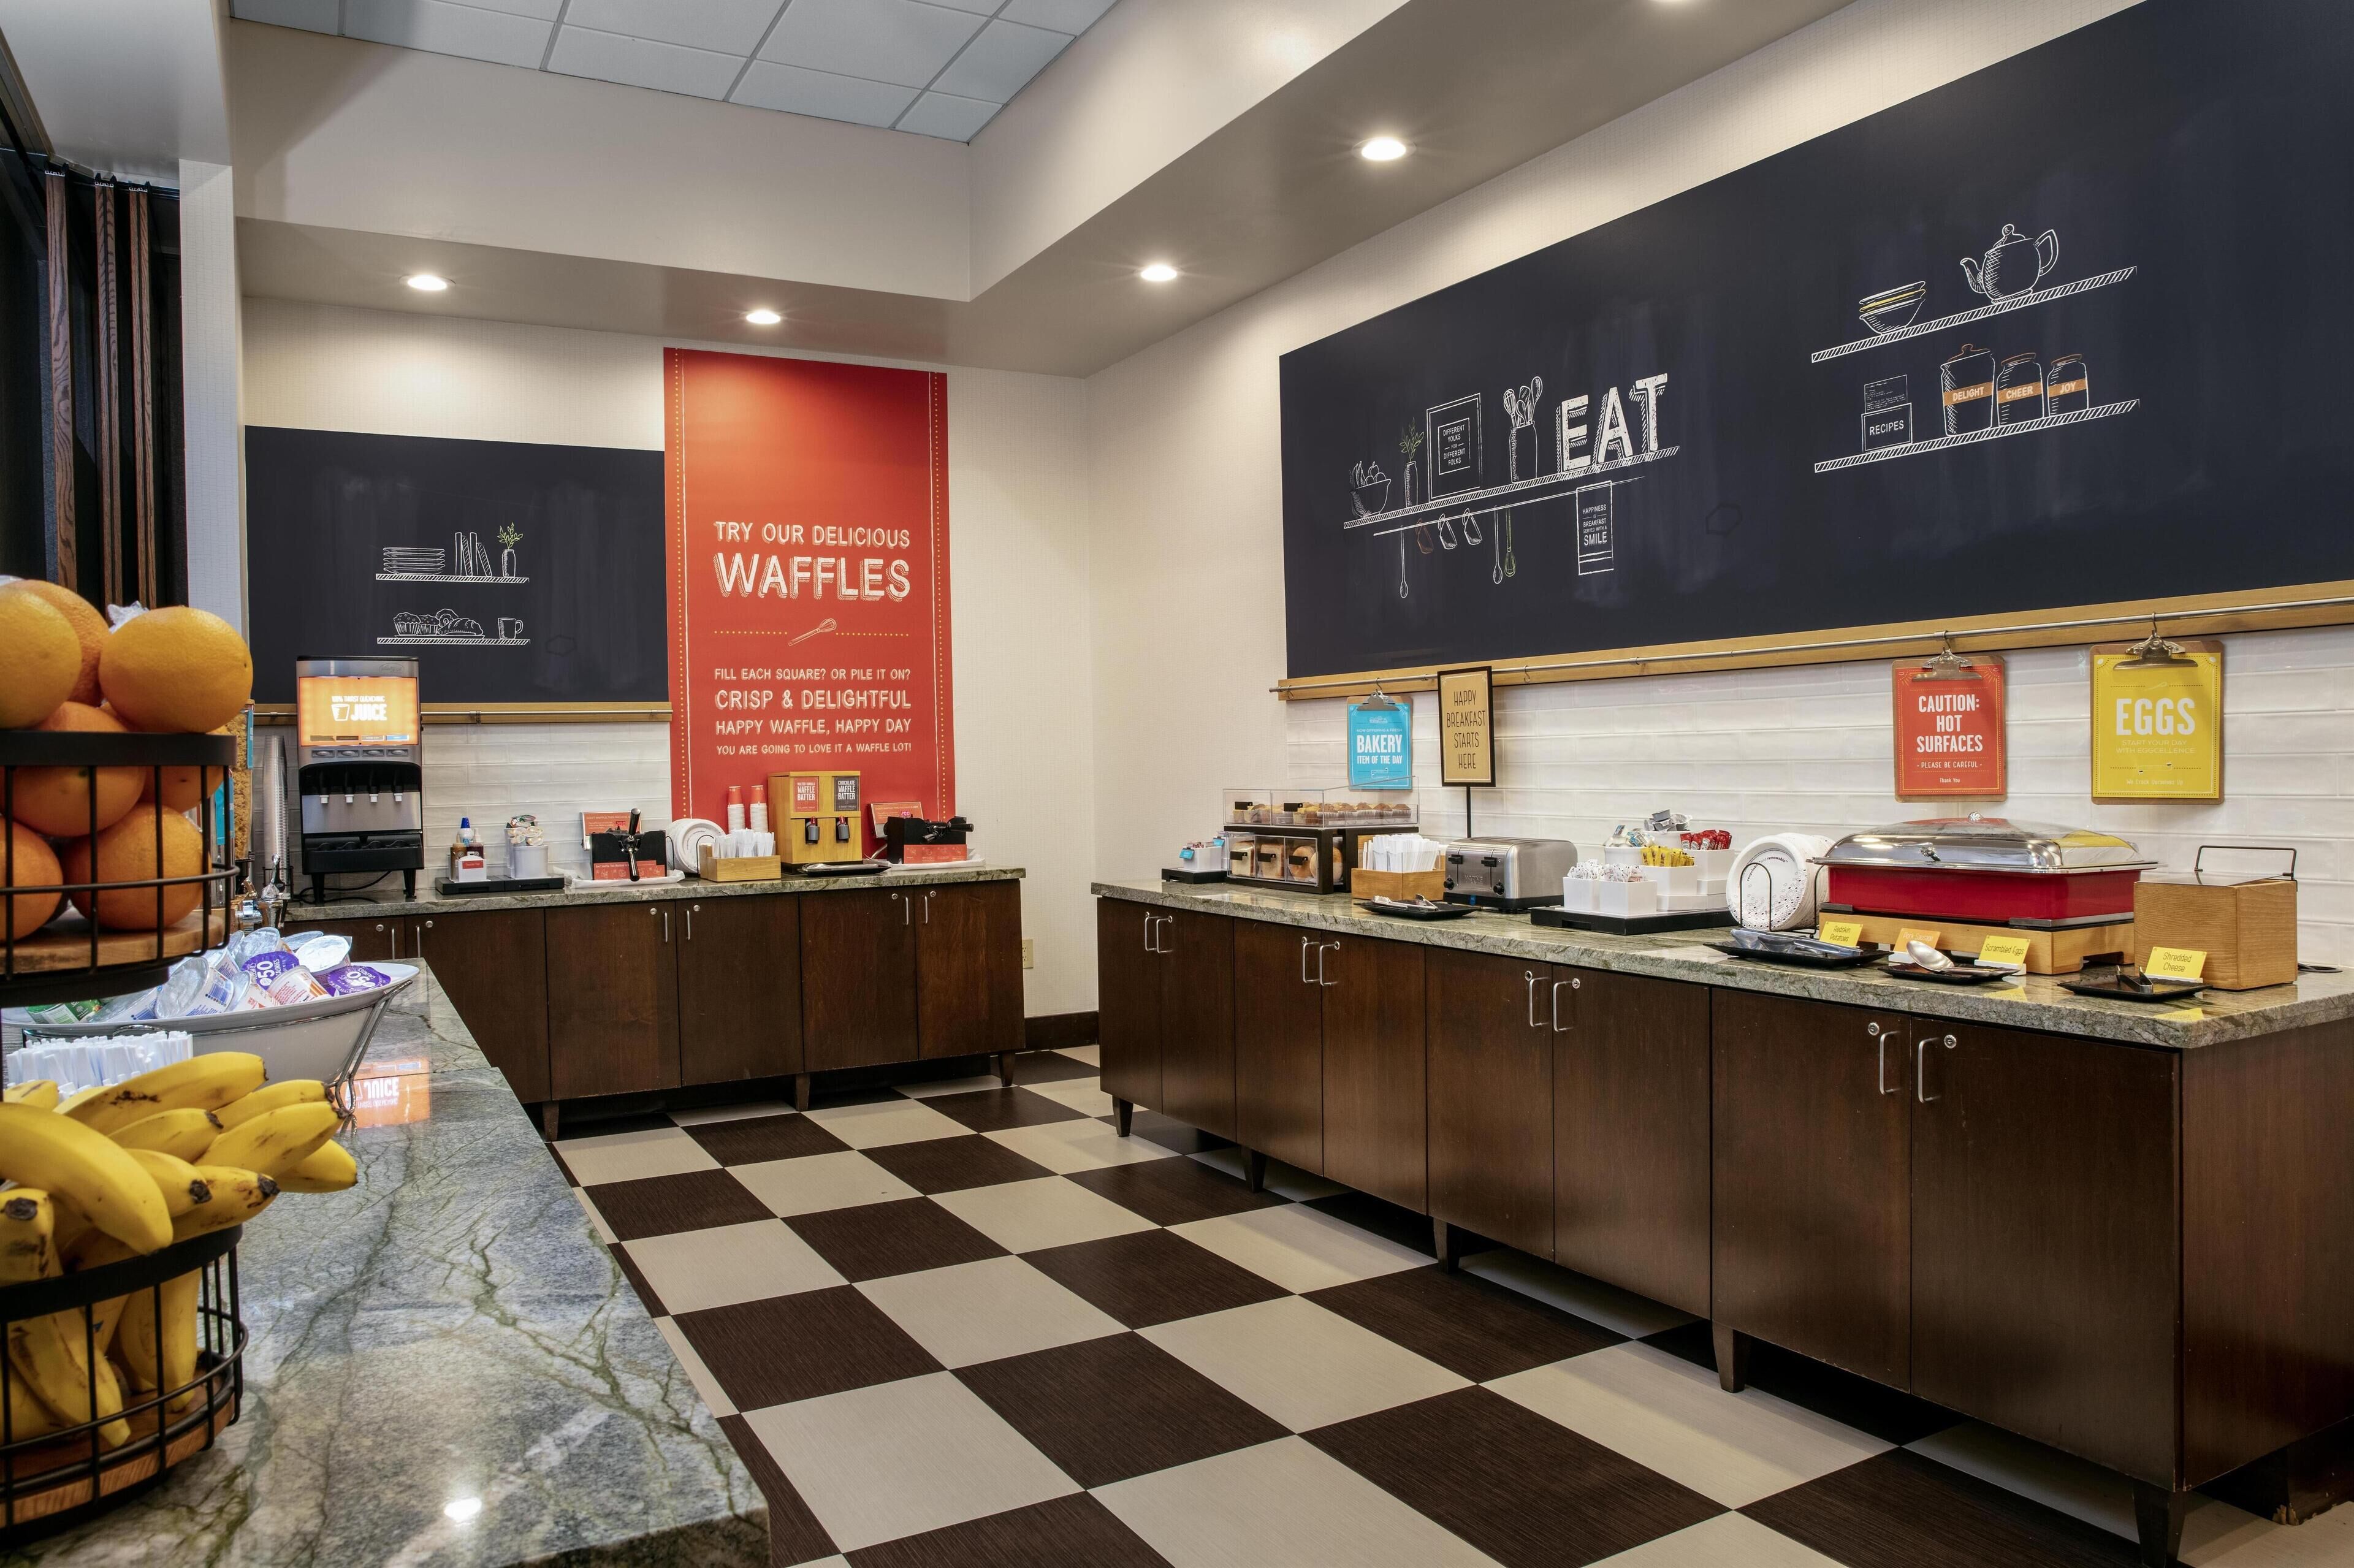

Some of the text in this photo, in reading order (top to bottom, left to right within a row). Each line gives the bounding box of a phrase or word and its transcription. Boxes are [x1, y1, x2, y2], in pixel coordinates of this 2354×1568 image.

[1952, 387, 1984, 402] DELIGHT
[2006, 386, 2033, 398] CHEER
[2060, 382, 2077, 394] JOY
[1443, 424, 1465, 436] DIFFERENT
[1555, 373, 1668, 473] EAT
[1870, 420, 1904, 435] RECIPES
[1448, 433, 1461, 442] YOLKS
[1444, 448, 1465, 459] DIFFERENT
[1582, 504, 1607, 514] HAPPINESS
[1583, 518, 1606, 527] BREAKFAST
[714, 521, 910, 549] TRY OUR DELICIOUS
[1584, 531, 1607, 546] SMILE
[713, 552, 911, 603] WAFFLES
[715, 668, 910, 680] FILL EACH SQUARE? OR PILE IT ON?
[715, 689, 912, 710] CRISP & DELIGHTFUL
[1453, 690, 1476, 707] HAPPY
[1918, 694, 1980, 713] CAUTION:
[351, 704, 387, 721] JUICE
[1446, 710, 1486, 728] BREAKFAST
[2116, 698, 2196, 736] EGGS
[716, 718, 912, 736] HAPPY WAFFLE, HAPPY DAY
[1937, 715, 1962, 733] HOT
[1357, 734, 1403, 753] BAKERY
[1454, 732, 1479, 748] STARTS
[1916, 734, 1983, 753] SURFACES
[717, 742, 912, 755] YOU ARE GOING TO LOVE IT A WAFFLE LOT!
[1357, 755, 1403, 764] ITEM OF THE DAY
[1458, 753, 1477, 769] HERE
[1985, 943, 2025, 956] Scrambled Eggs
[2163, 951, 2192, 962] Shredded
[2163, 962, 2185, 972] Cheese
